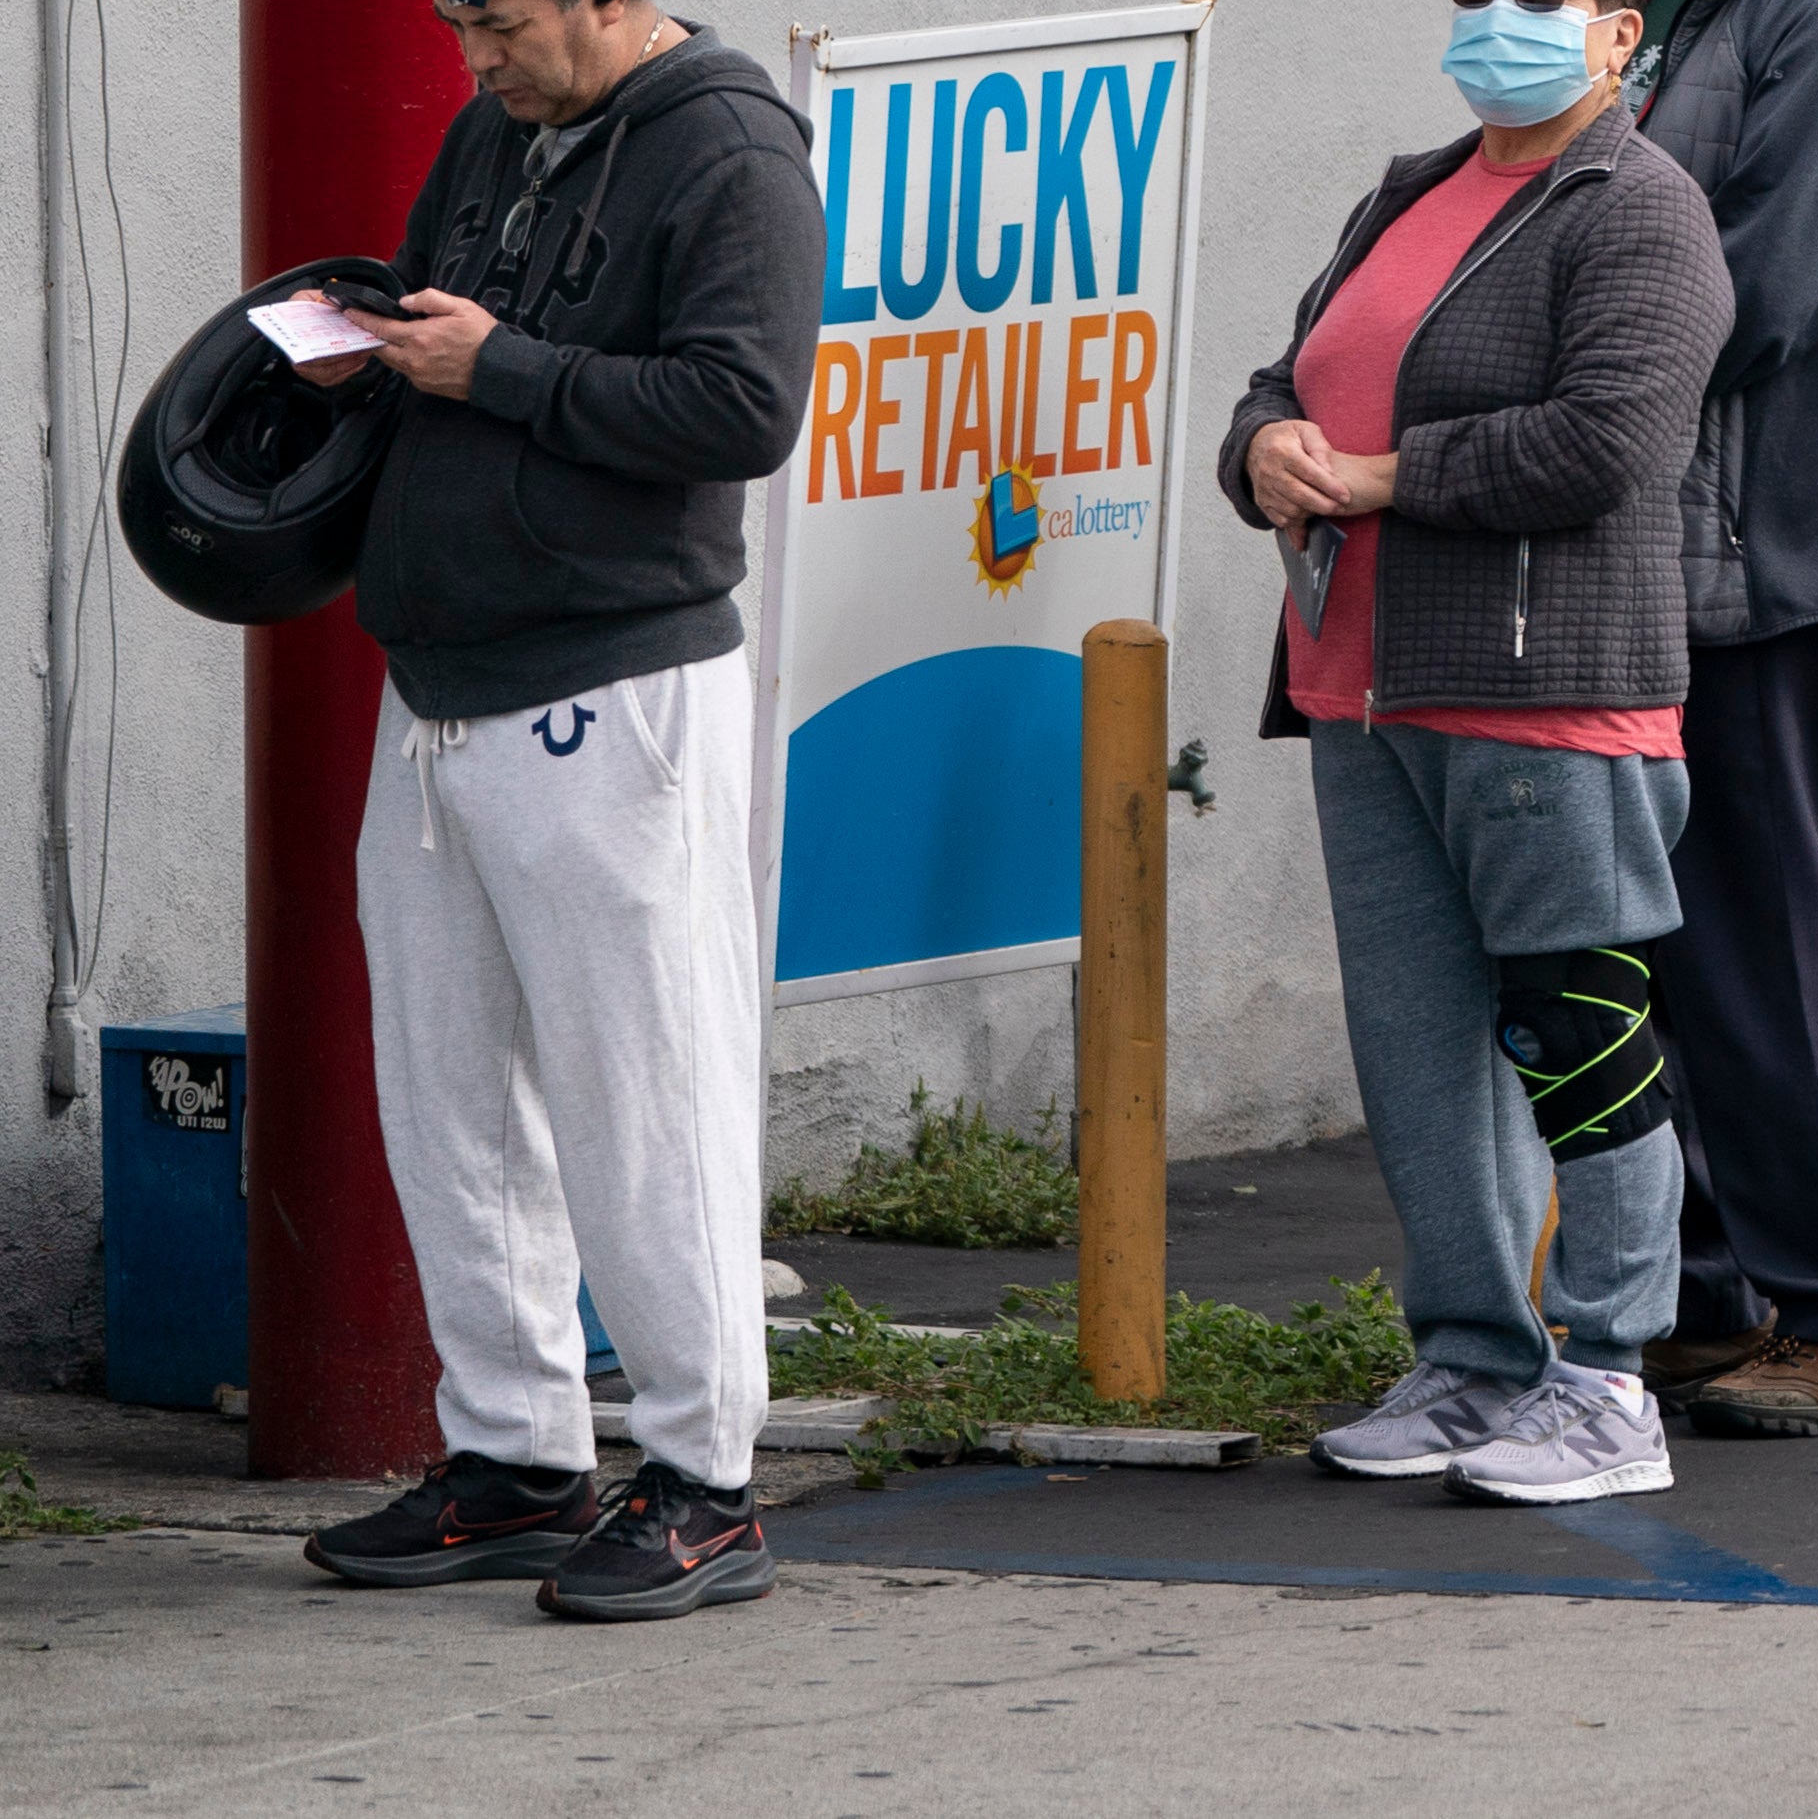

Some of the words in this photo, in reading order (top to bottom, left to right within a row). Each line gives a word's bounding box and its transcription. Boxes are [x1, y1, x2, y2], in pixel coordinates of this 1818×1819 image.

[820, 60, 1176, 325] LUCKY
[807, 309, 1157, 505] RETAILER
[1048, 494, 1151, 541] calottery
